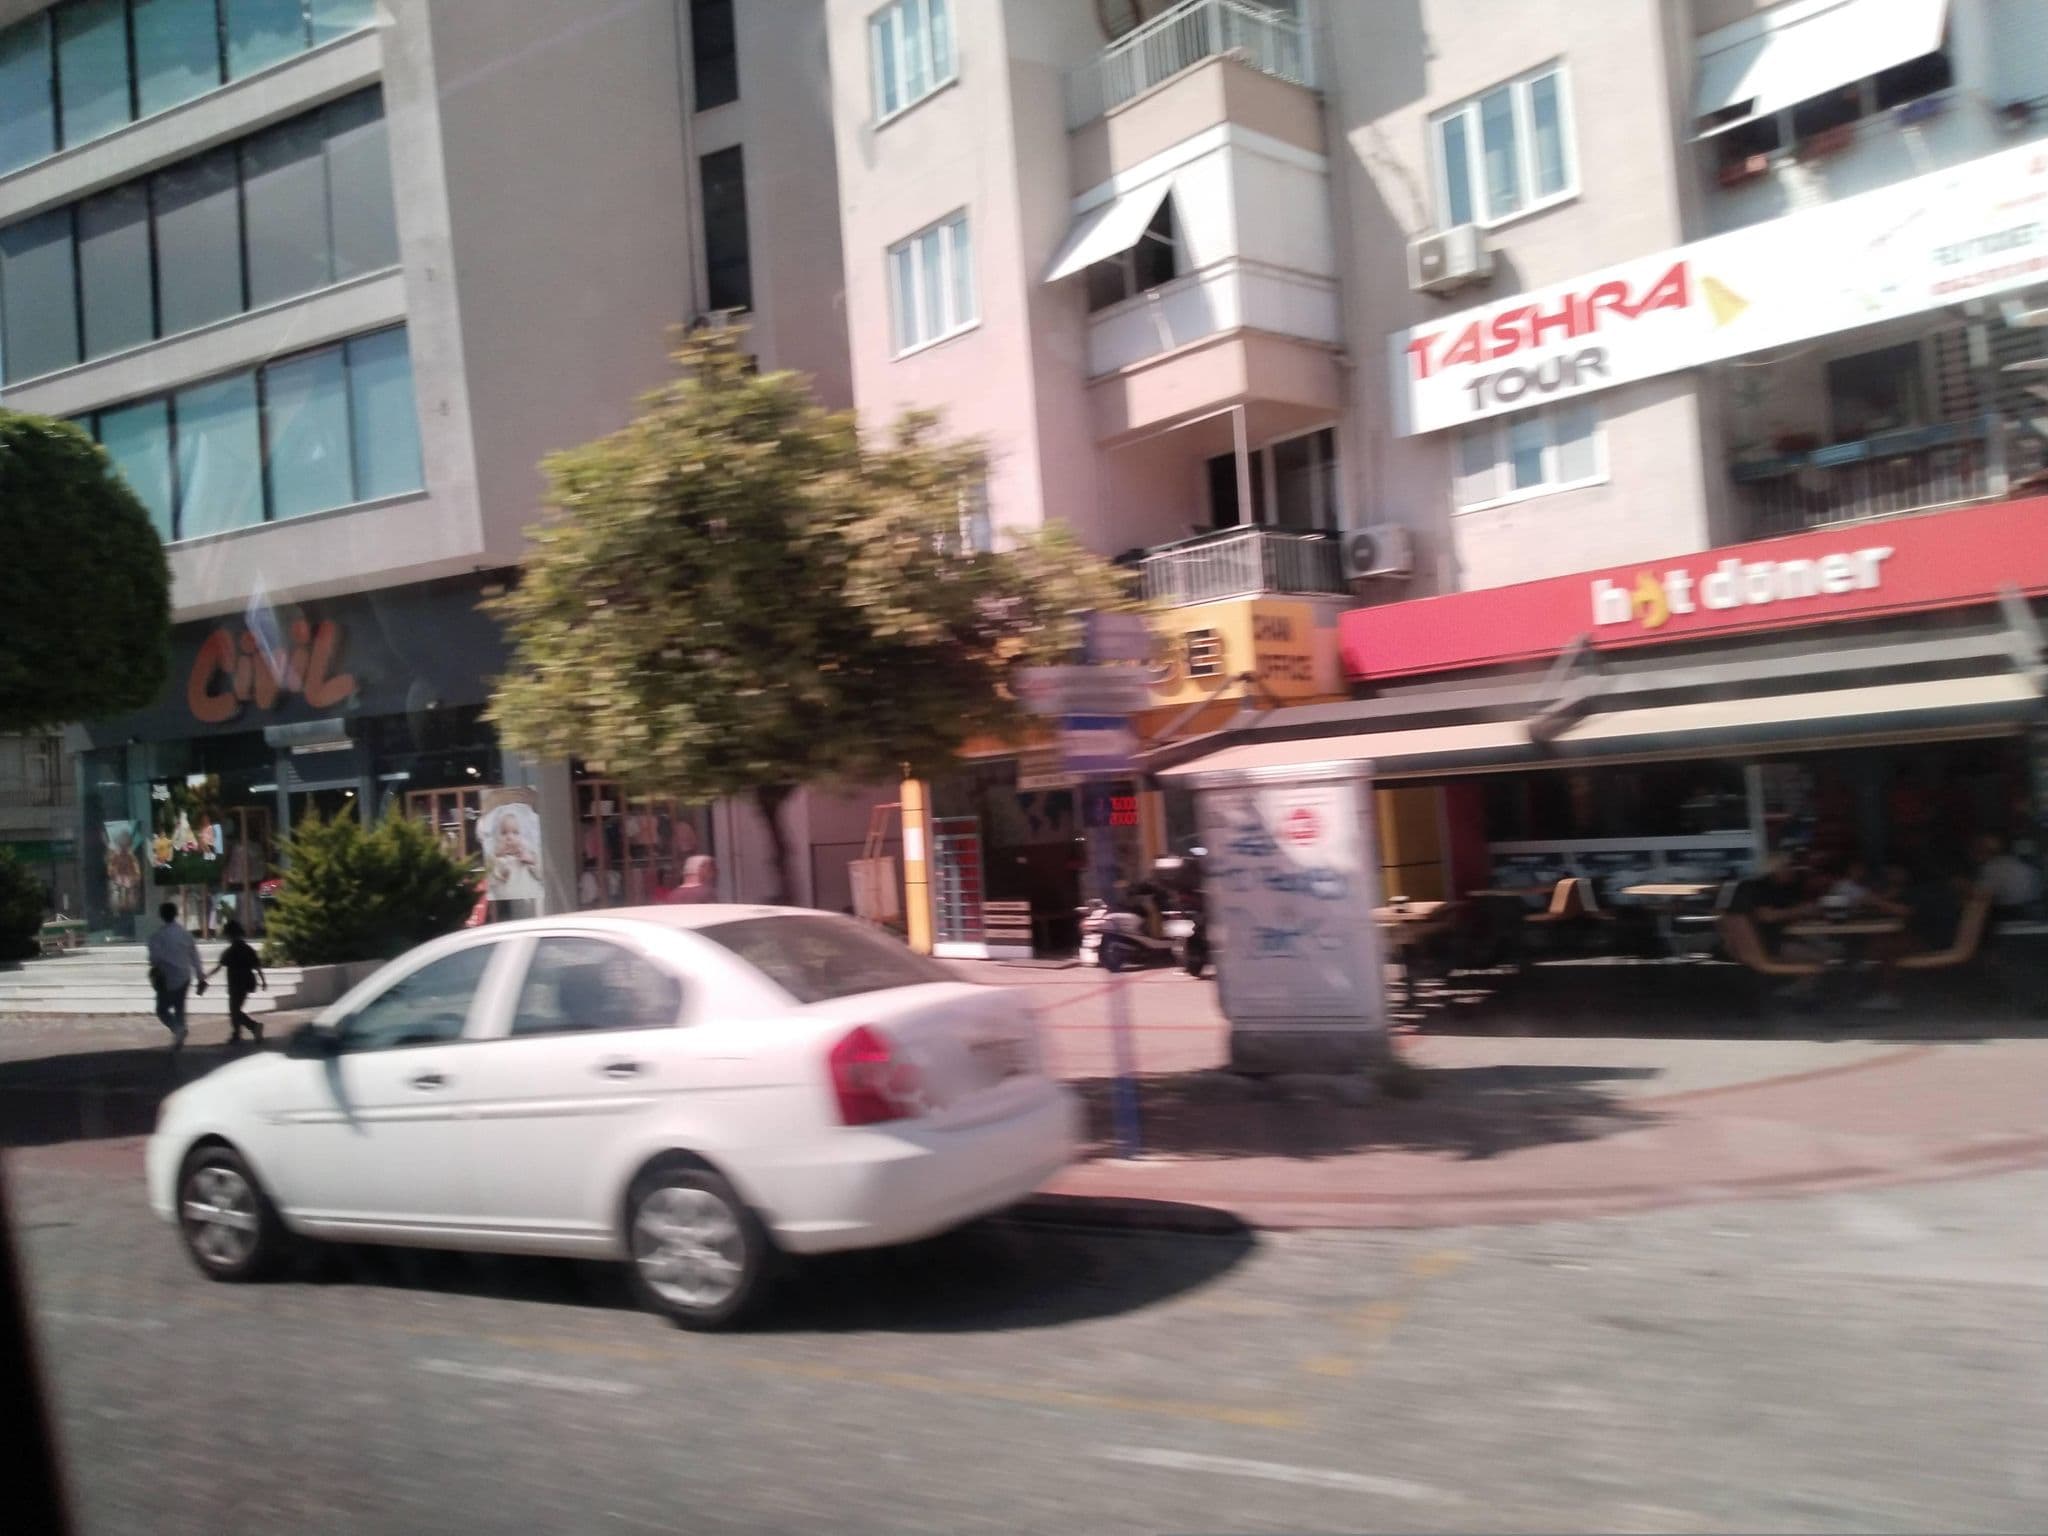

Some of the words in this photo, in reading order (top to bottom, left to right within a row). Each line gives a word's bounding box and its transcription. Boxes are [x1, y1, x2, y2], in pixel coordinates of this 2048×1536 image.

[1403, 260, 1693, 380] TASHRA
[1465, 346, 1611, 411] TOUR
[1591, 571, 1696, 629] hot
